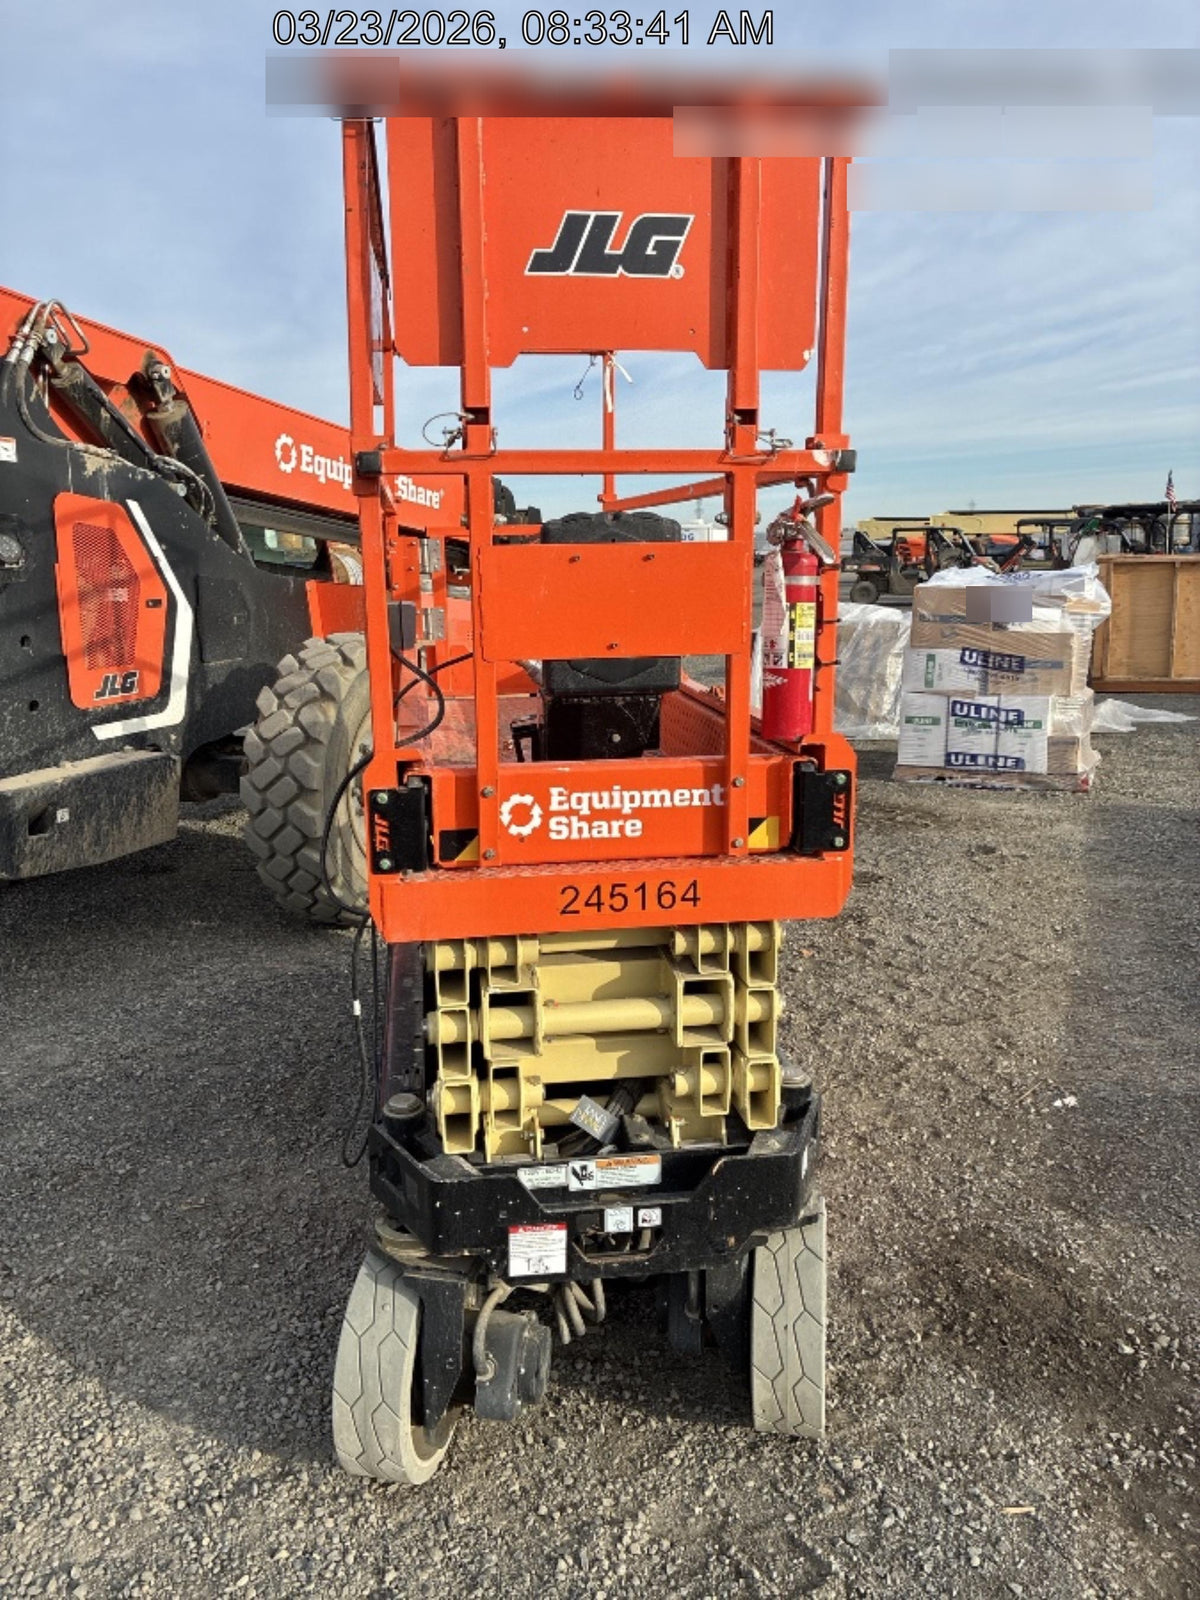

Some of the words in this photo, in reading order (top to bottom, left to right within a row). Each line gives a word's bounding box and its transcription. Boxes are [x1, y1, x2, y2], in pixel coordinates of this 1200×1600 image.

[523, 210, 695, 278] JLG
[301, 444, 353, 490] Equip
[963, 650, 1022, 671] ULINE
[94, 670, 139, 700] JLG
[955, 703, 1019, 723] ULINE
[950, 754, 1018, 768] ULINE
[549, 784, 727, 815] Equipment
[549, 815, 643, 840] Share
[560, 879, 701, 915] 245164
